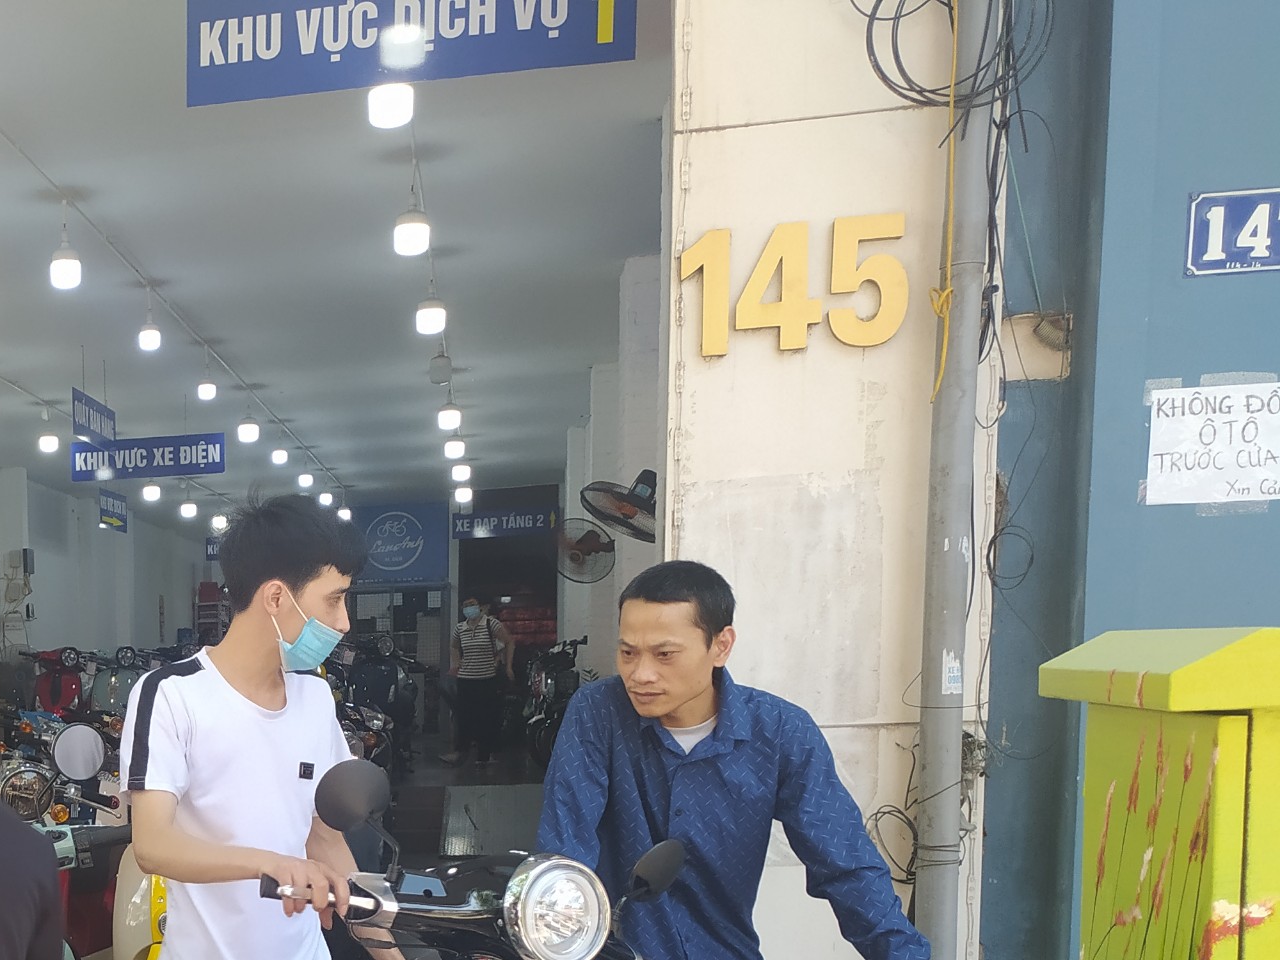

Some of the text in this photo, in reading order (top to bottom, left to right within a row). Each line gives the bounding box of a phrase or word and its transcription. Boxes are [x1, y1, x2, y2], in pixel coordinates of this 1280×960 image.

[199, 13, 282, 67] KHU
[296, 0, 378, 62] VỰC
[1203, 204, 1280, 260] 14
[681, 212, 910, 357] 145
[1156, 391, 1234, 419] KHÔNG
[75, 441, 220, 472] KHU VỰC XE ĐIỆN
[1153, 447, 1224, 474] TRƯỚC
[1226, 479, 1251, 497] Xin
[455, 519, 470, 531] XE
[536, 515, 544, 527] 2
